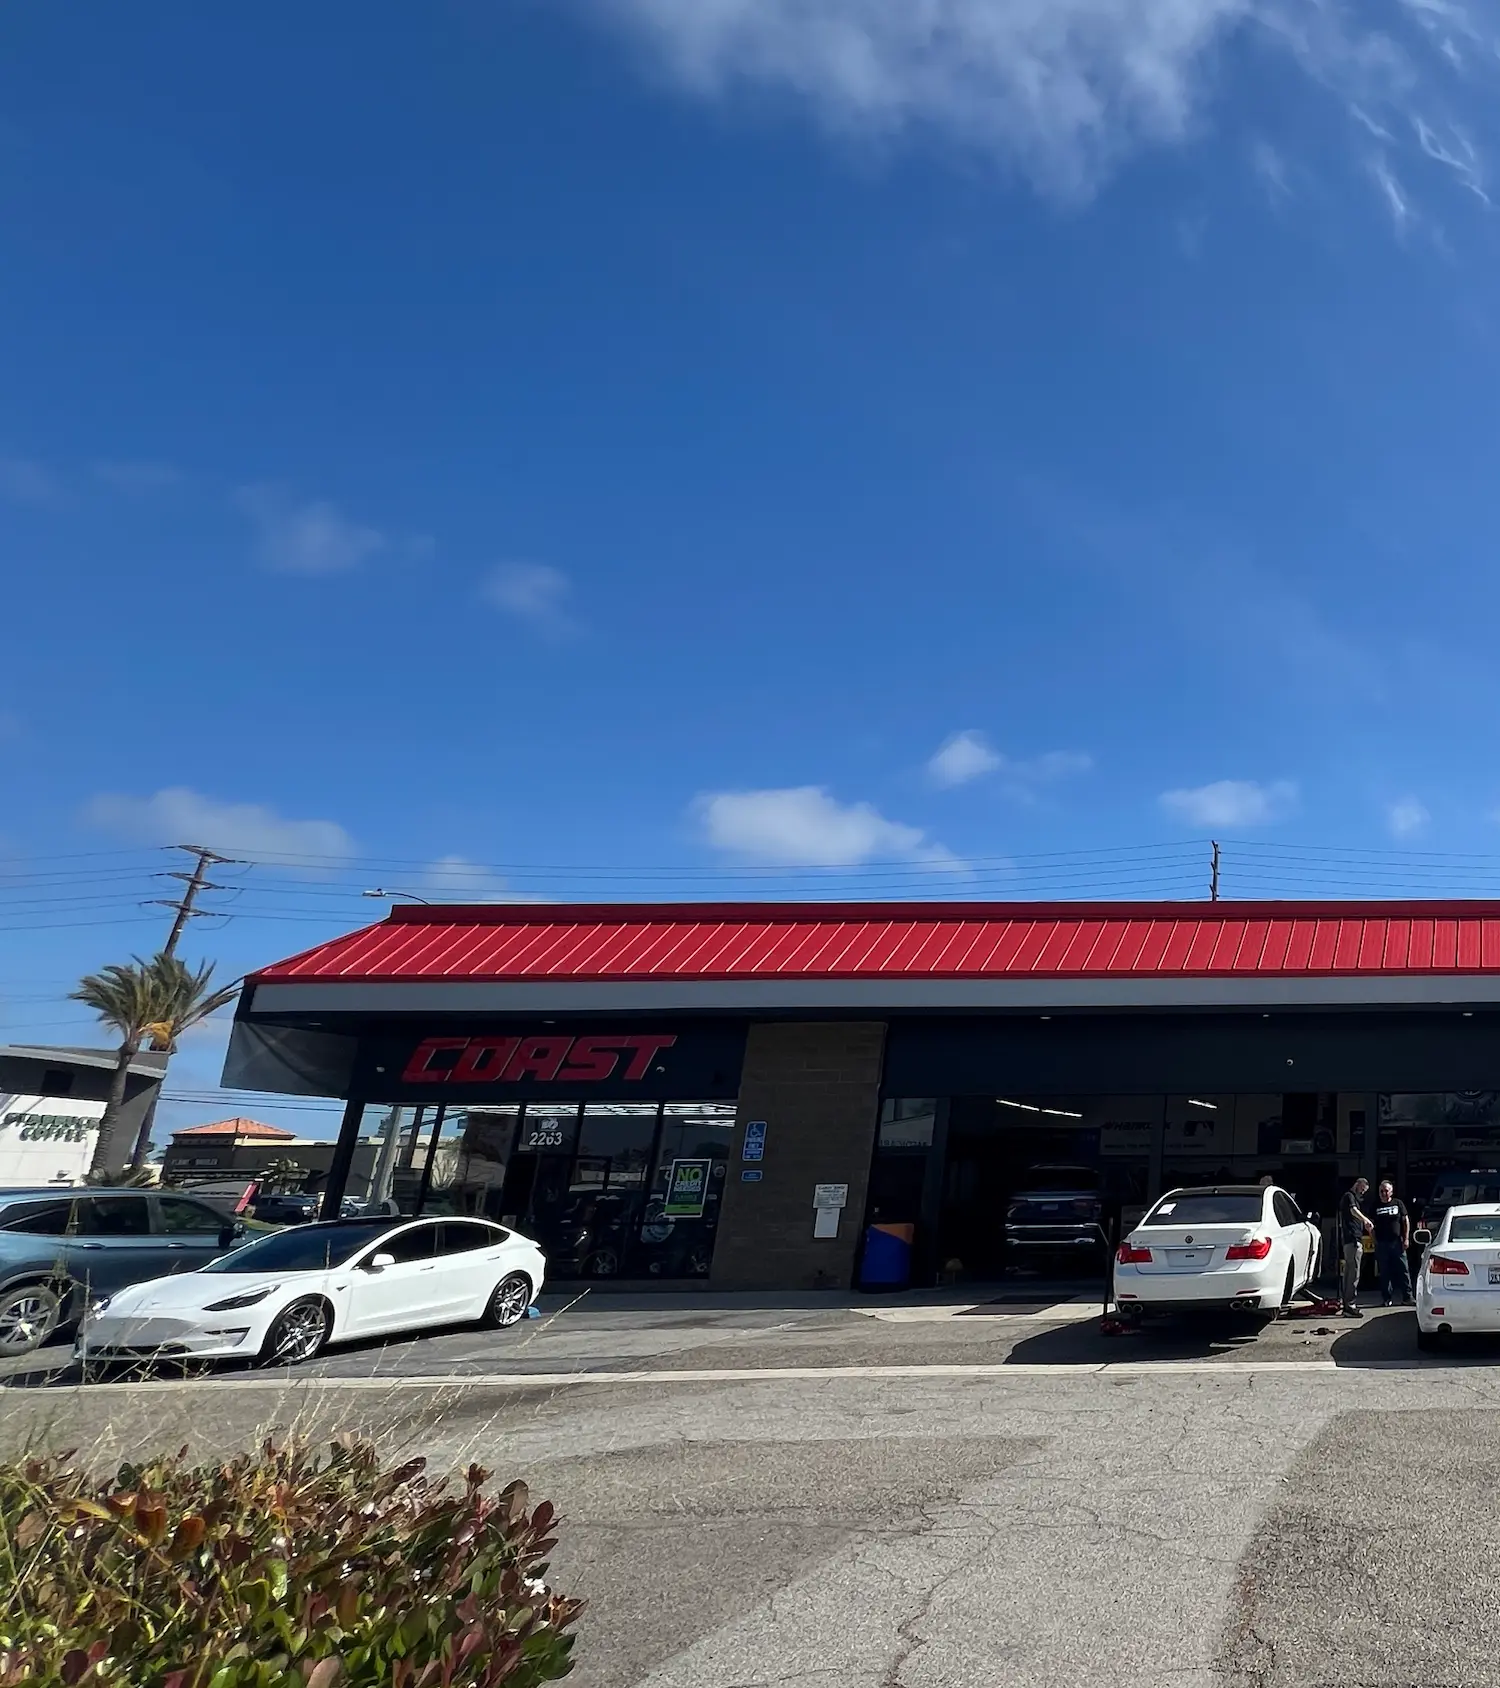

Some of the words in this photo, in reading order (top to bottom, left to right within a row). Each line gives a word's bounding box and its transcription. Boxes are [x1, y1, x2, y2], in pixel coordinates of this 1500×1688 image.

[401, 1035, 678, 1082] COAST
[19, 1125, 87, 1142] COFFEE
[528, 1131, 563, 1146] 2263
[676, 1167, 703, 1181] NO
